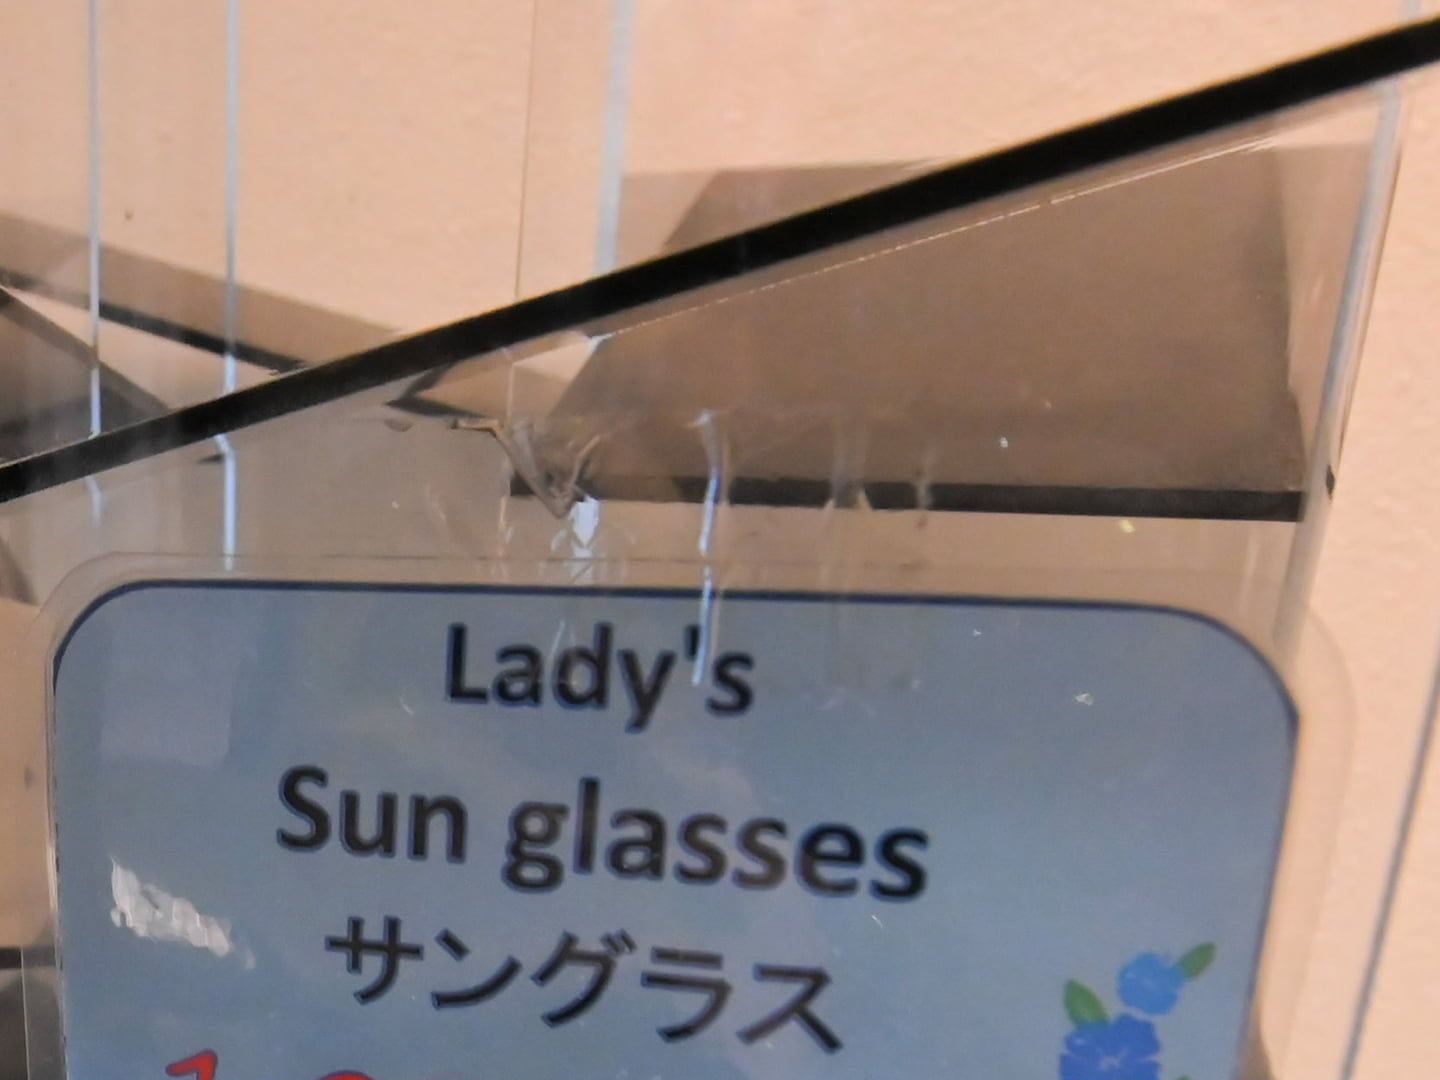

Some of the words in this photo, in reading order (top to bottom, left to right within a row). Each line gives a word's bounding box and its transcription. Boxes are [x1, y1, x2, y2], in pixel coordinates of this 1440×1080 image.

[445, 622, 756, 732] Lady's
[276, 765, 469, 863] Sun
[504, 777, 929, 900] glasses
[325, 917, 842, 1052] サングラス
